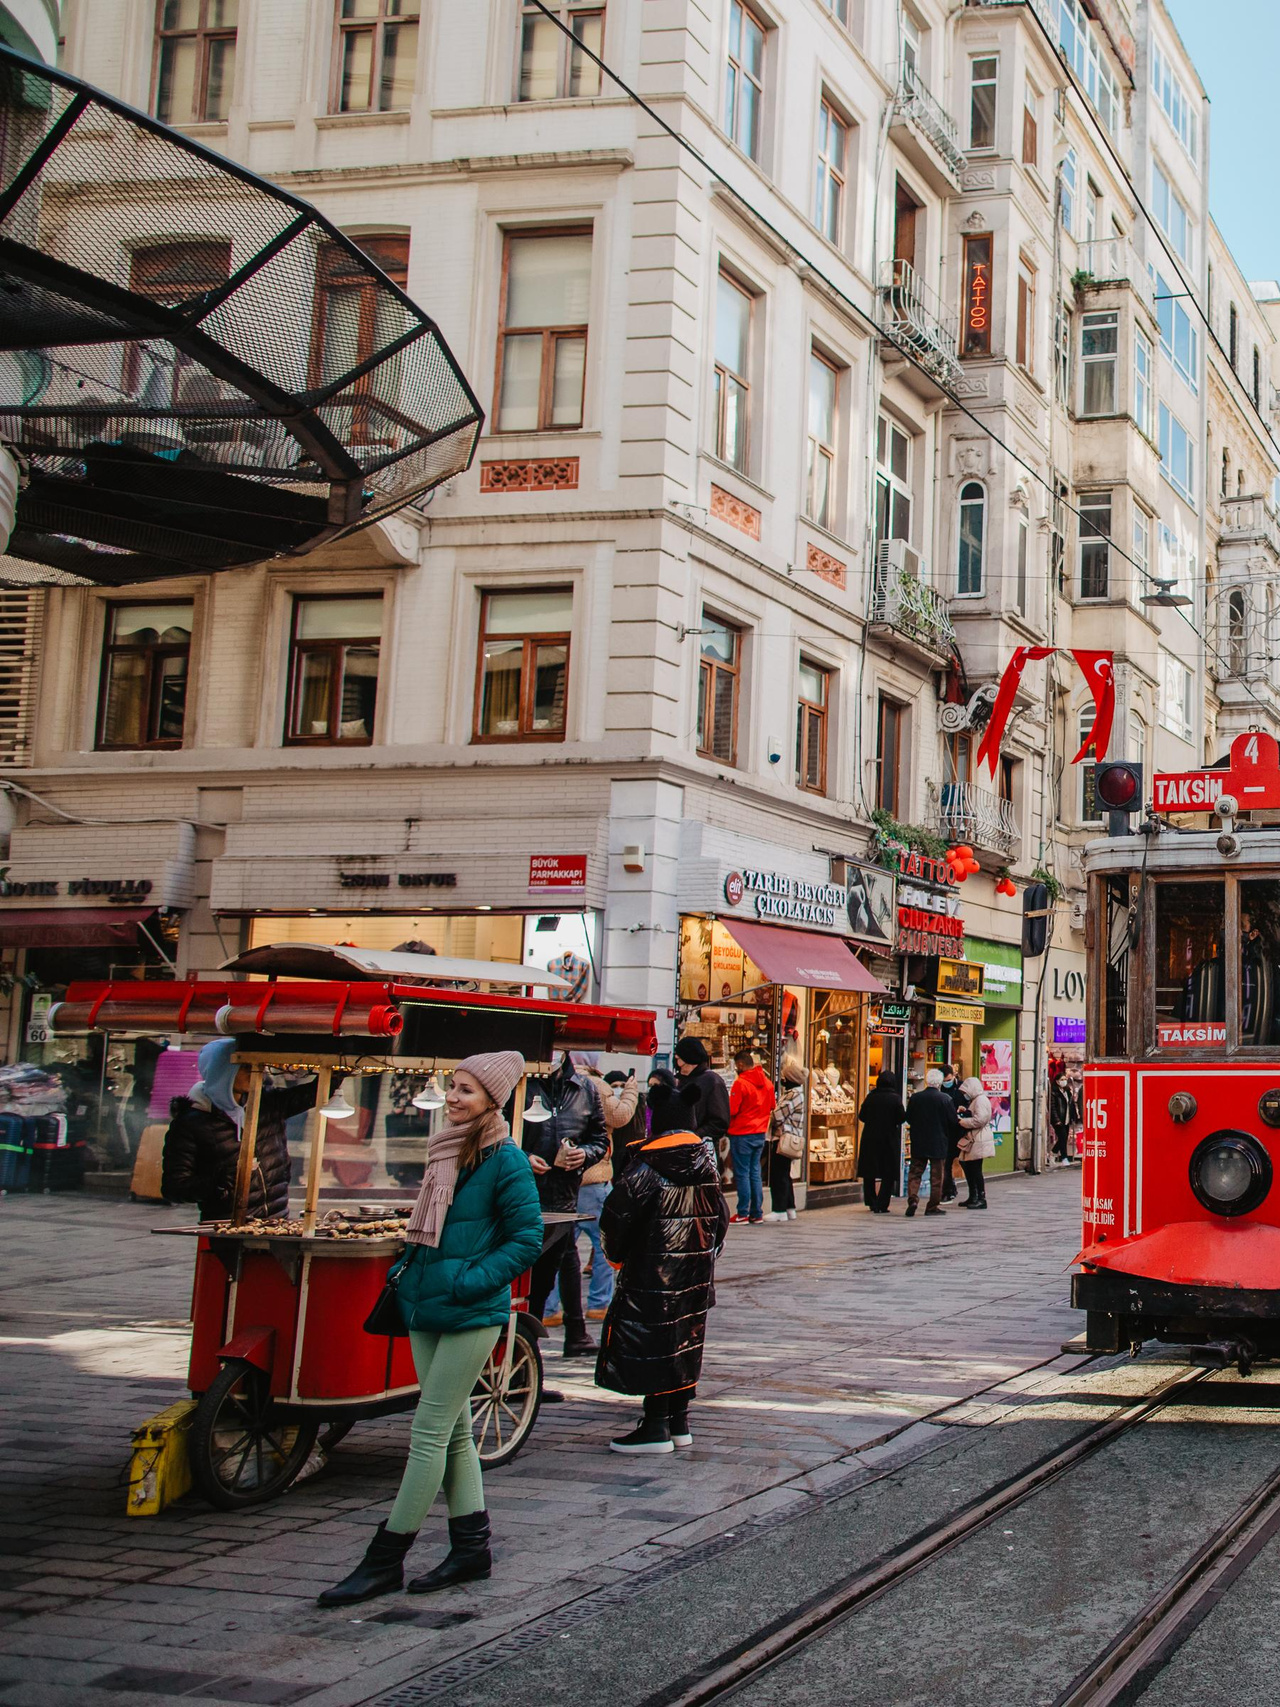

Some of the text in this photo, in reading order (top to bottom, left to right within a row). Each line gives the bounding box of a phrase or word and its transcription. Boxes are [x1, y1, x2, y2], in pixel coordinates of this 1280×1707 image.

[970, 264, 986, 328] TATTOO
[1244, 736, 1259, 765] 4
[1156, 774, 1223, 805] TAKSİM
[531, 869, 583, 879] PARMAKKAPI
[532, 858, 559, 868] BÜYÜK
[900, 851, 956, 885] TATTOO
[729, 878, 743, 896] elit
[744, 869, 847, 907] TARİHİ BEYOĞLU
[757, 892, 836, 926] ÇİKOLATACISI
[713, 945, 742, 958] BEYOĞLU
[900, 930, 965, 958] CLUB VEGAS
[31, 1030, 47, 1041] 60
[1161, 1026, 1227, 1042] TAKSİM
[1086, 1098, 1108, 1129] 115
